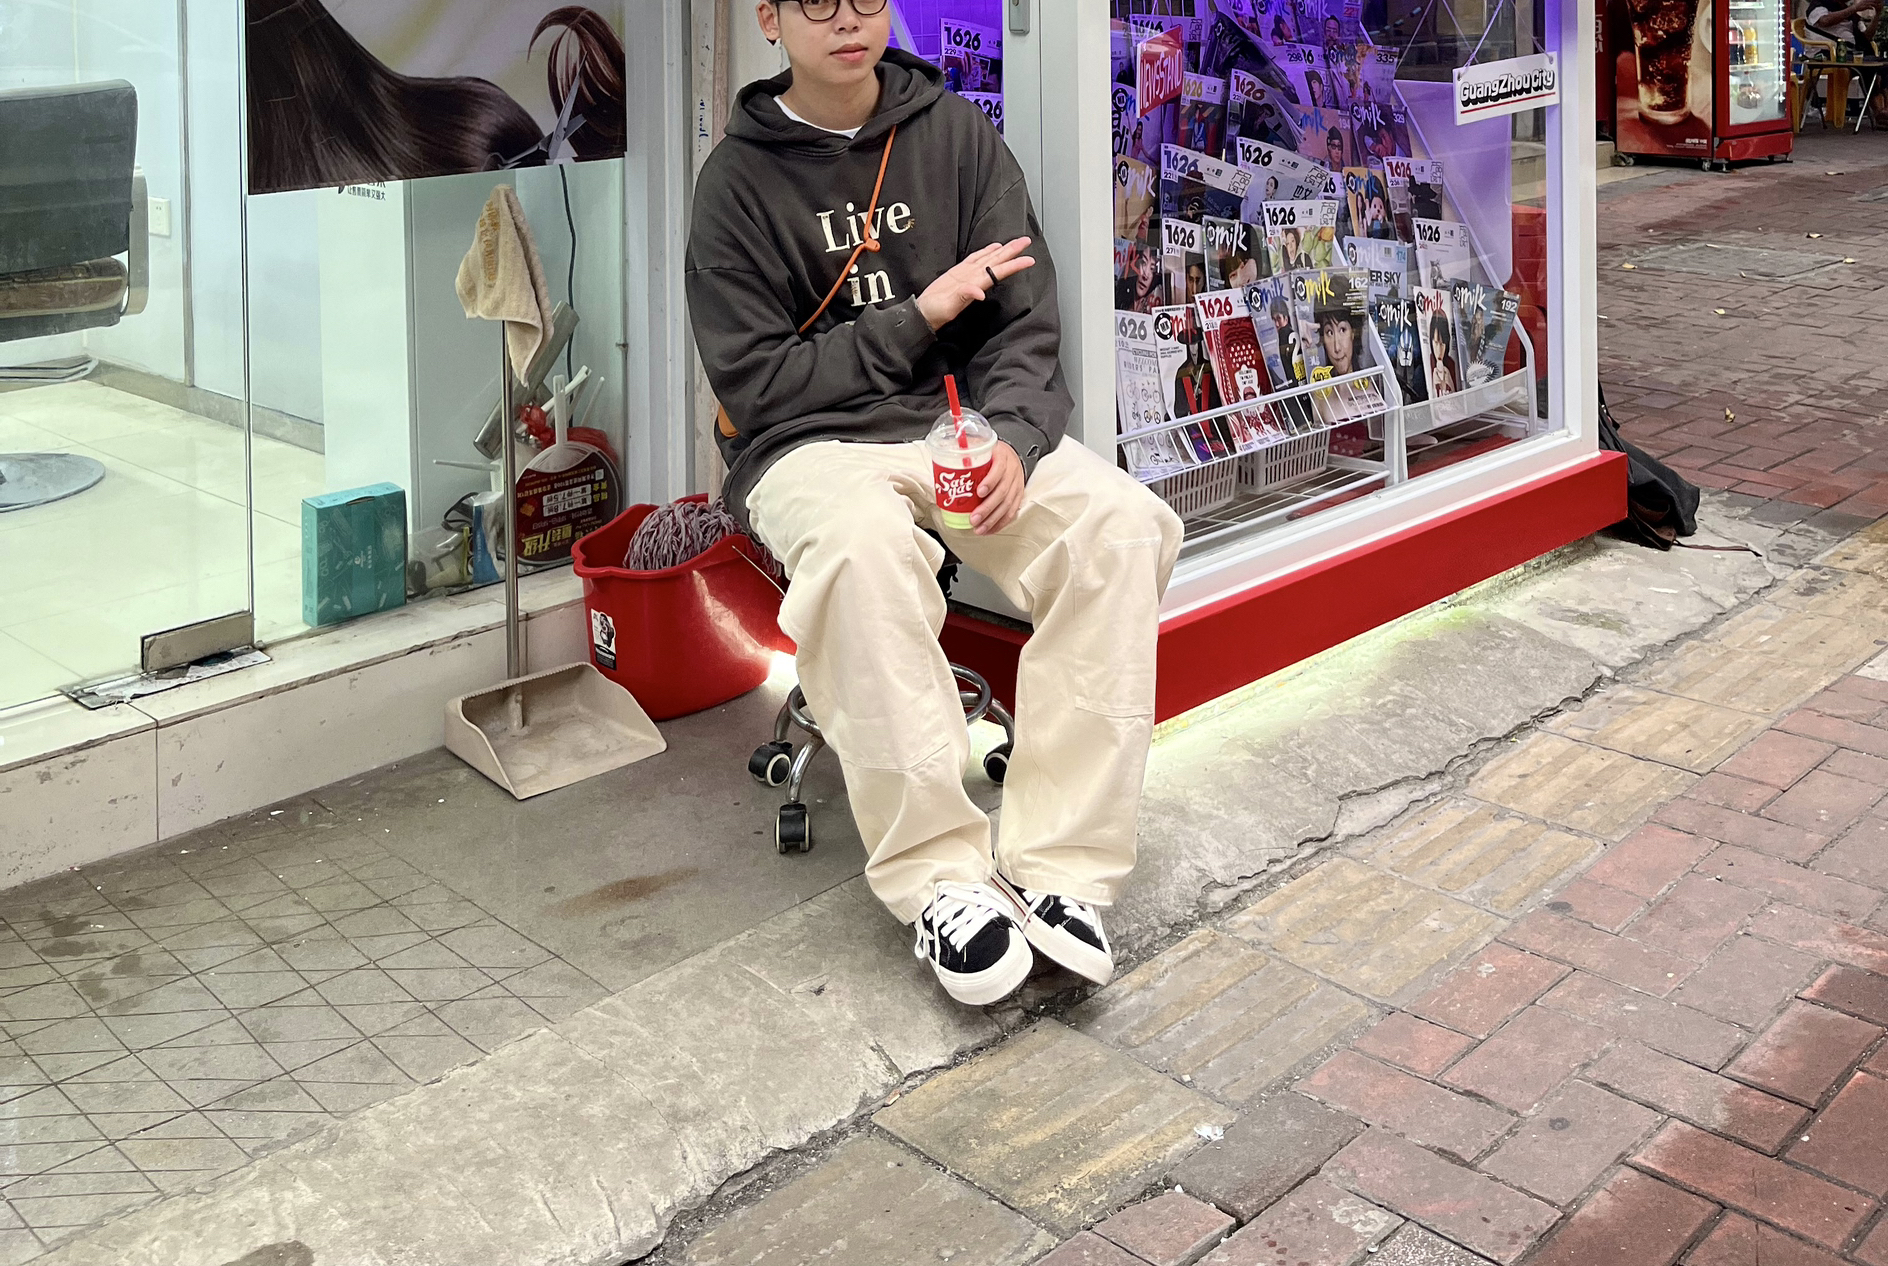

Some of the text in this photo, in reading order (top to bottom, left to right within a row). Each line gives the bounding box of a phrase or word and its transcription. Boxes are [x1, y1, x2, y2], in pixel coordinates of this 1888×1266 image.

[944, 26, 982, 52] 1626
[1376, 51, 1395, 64] 335
[1234, 75, 1267, 101] 1626
[1361, 100, 1386, 131] milk
[1163, 149, 1200, 175] 1626
[1240, 142, 1274, 167] 1626
[1386, 160, 1412, 178] 1626
[815, 198, 911, 254] Live
[1265, 206, 1296, 227] 1626
[1165, 224, 1196, 249] 1626
[1214, 222, 1248, 257] milk
[1416, 223, 1441, 243] 1626
[846, 264, 896, 308] in
[1304, 270, 1335, 306] milk
[1348, 276, 1369, 289] 162
[1384, 270, 1402, 285] SKY
[1261, 276, 1289, 308] milk
[1423, 290, 1444, 314] milk
[1460, 283, 1488, 315] milk
[1199, 296, 1234, 319] 1626
[1386, 298, 1412, 333] milk
[1501, 298, 1518, 313] 192
